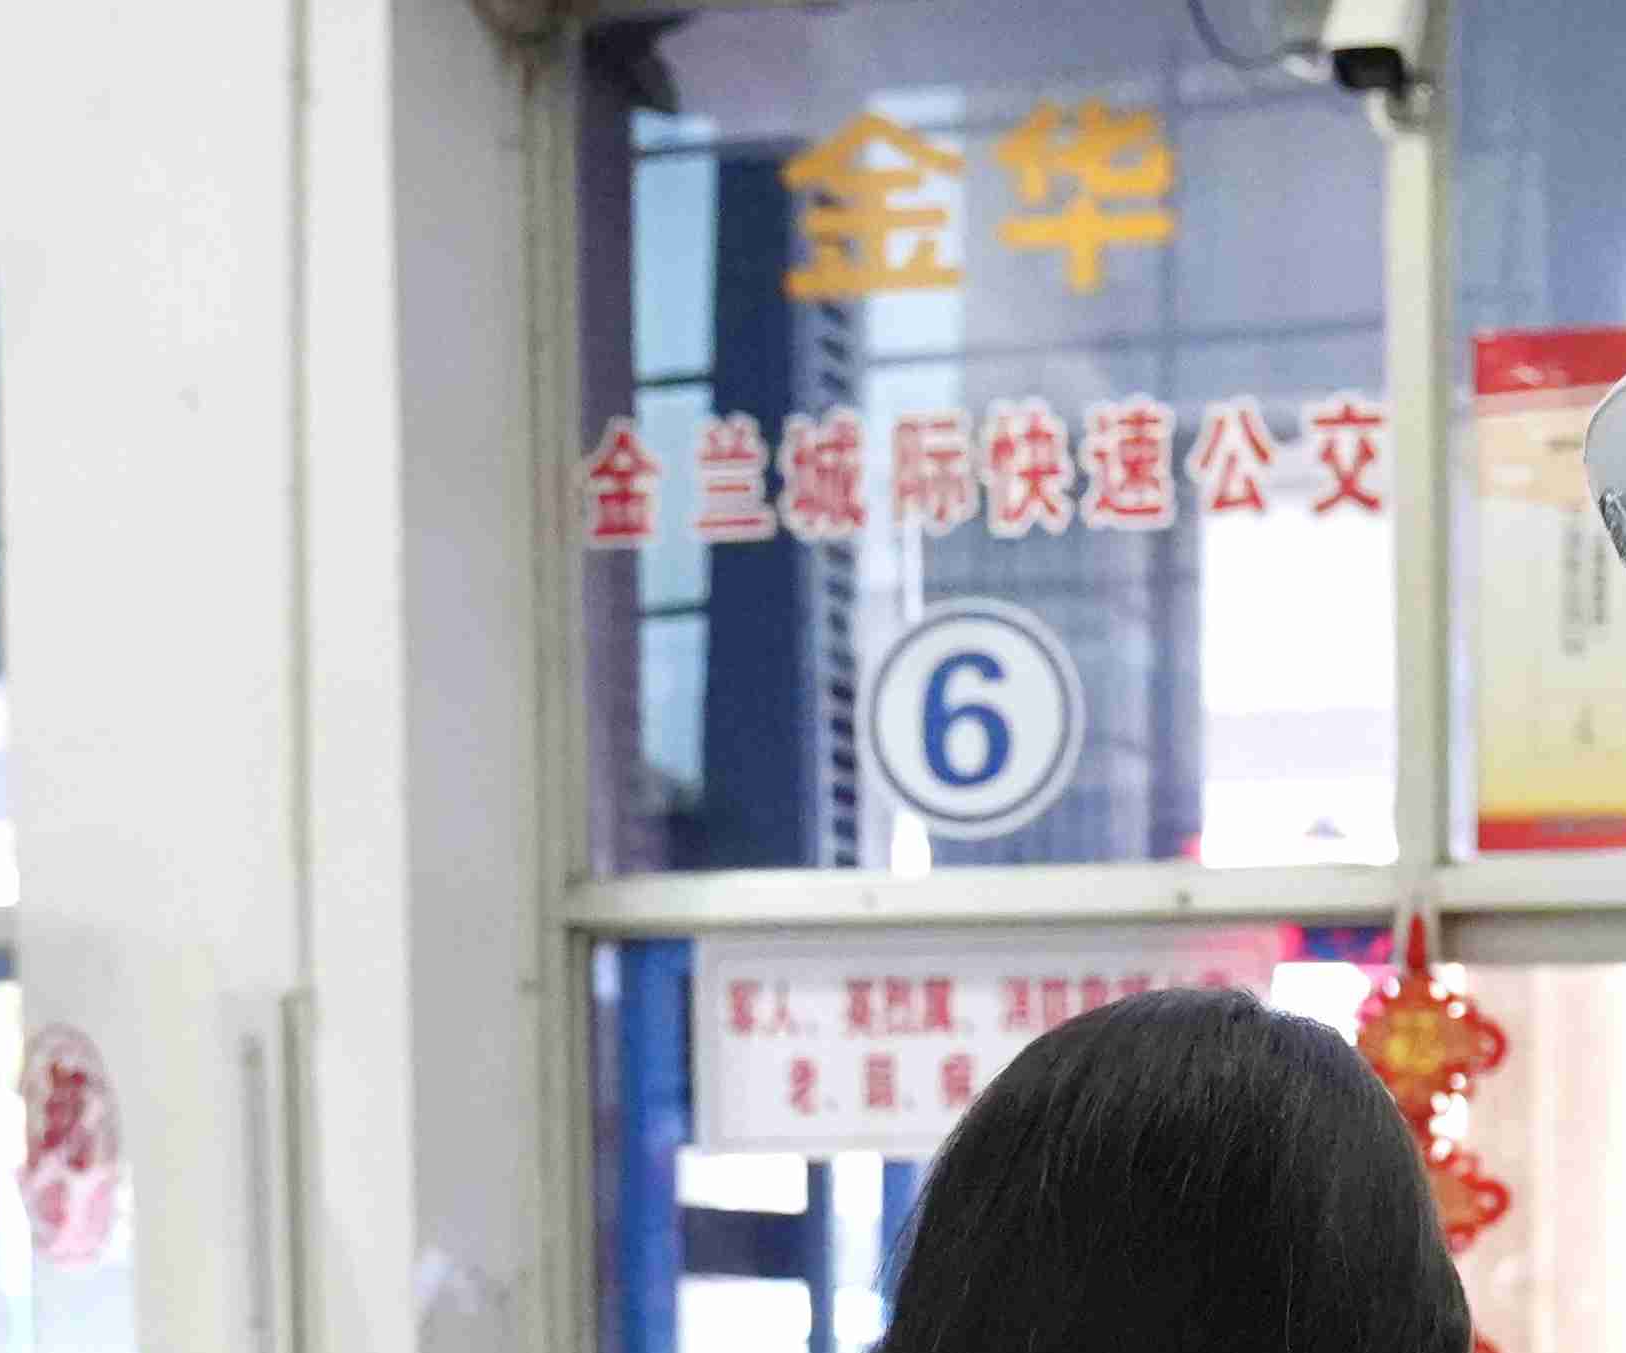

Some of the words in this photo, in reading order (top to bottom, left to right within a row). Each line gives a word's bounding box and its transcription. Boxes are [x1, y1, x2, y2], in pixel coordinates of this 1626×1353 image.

[780, 98, 1176, 302] 金华
[586, 402, 1386, 542] 金兰城际快速公交
[920, 650, 1013, 788] 6
